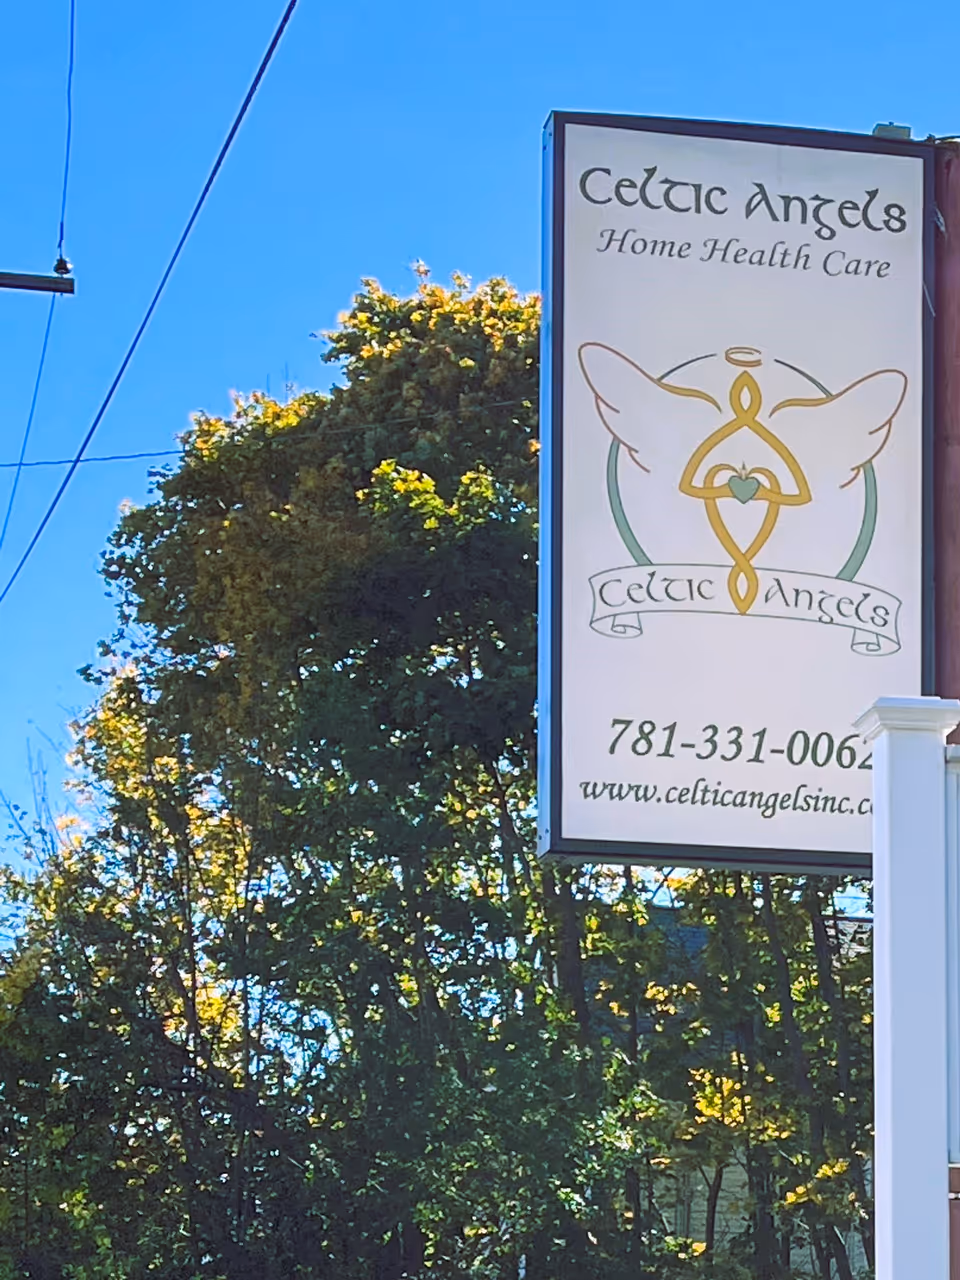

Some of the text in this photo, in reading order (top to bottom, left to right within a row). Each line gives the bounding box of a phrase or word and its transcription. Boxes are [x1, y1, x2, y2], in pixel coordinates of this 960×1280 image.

[579, 166, 907, 240] Celtic Angels
[596, 228, 891, 278] Home Health Care
[598, 571, 890, 628] Celtic Angels
[579, 778, 873, 819] www.celticangelsinc.c
